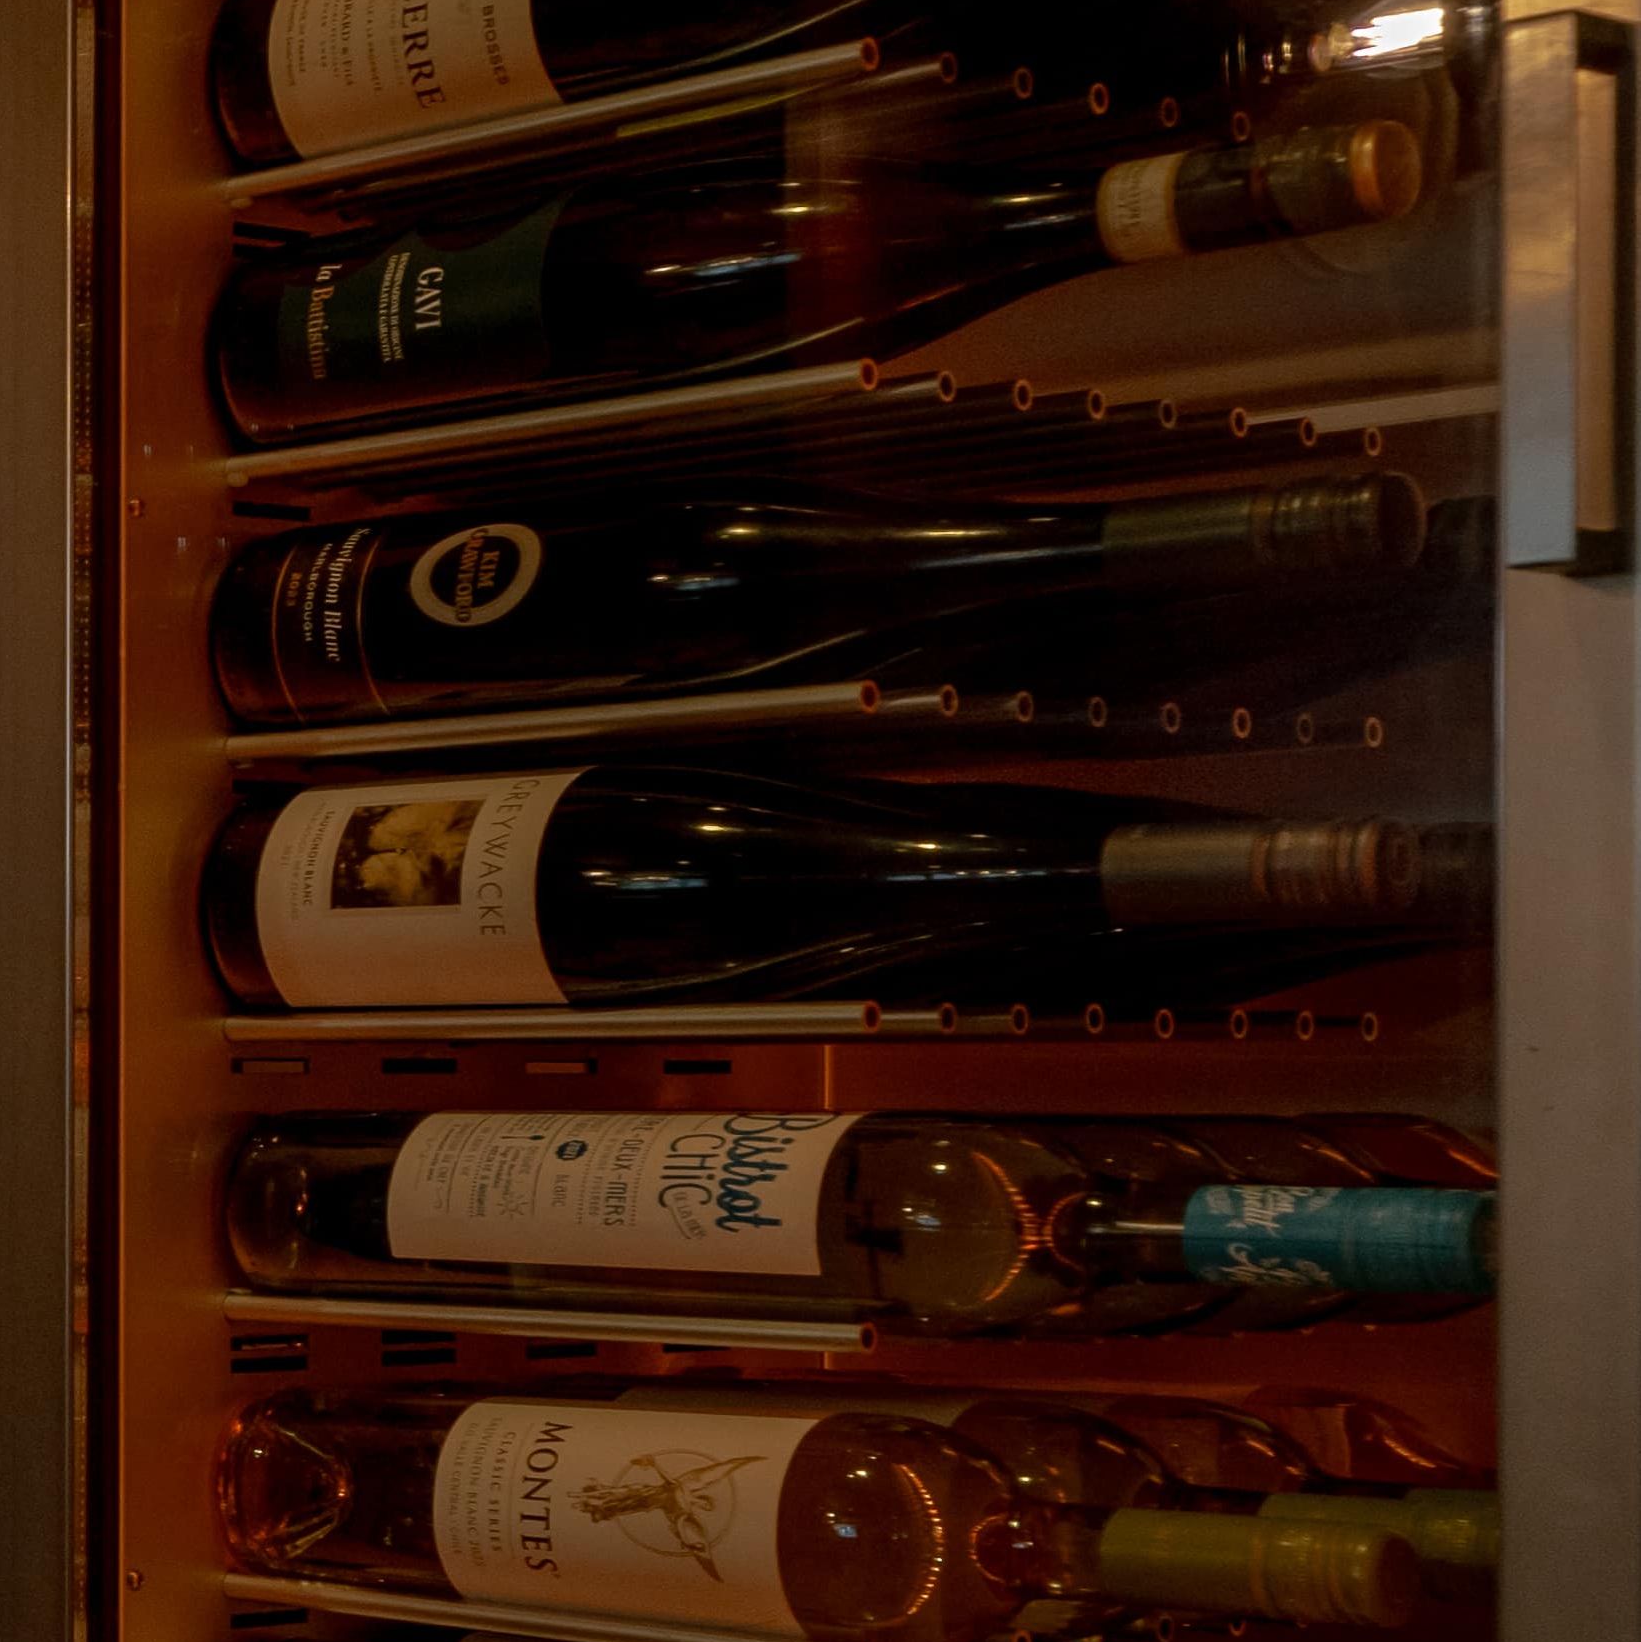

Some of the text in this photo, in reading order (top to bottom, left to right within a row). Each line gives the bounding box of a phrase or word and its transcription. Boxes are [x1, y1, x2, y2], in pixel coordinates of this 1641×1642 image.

[480, 5, 511, 87] BROSSES
[304, 286, 337, 380] Battistina
[414, 266, 445, 331] GAVI
[302, 543, 333, 642] MARLBOROUGH
[323, 527, 373, 662] Sauvignon Blanc
[453, 528, 490, 621] CRAWFORD
[480, 551, 500, 588] KIM
[302, 809, 336, 906] SAUVIGNON BLANC
[478, 779, 541, 936] GREYWACKE
[714, 1113, 837, 1233] Bistrot
[489, 1431, 516, 1552] CLASSIC SERIES
[519, 1421, 573, 1572] MONTES
